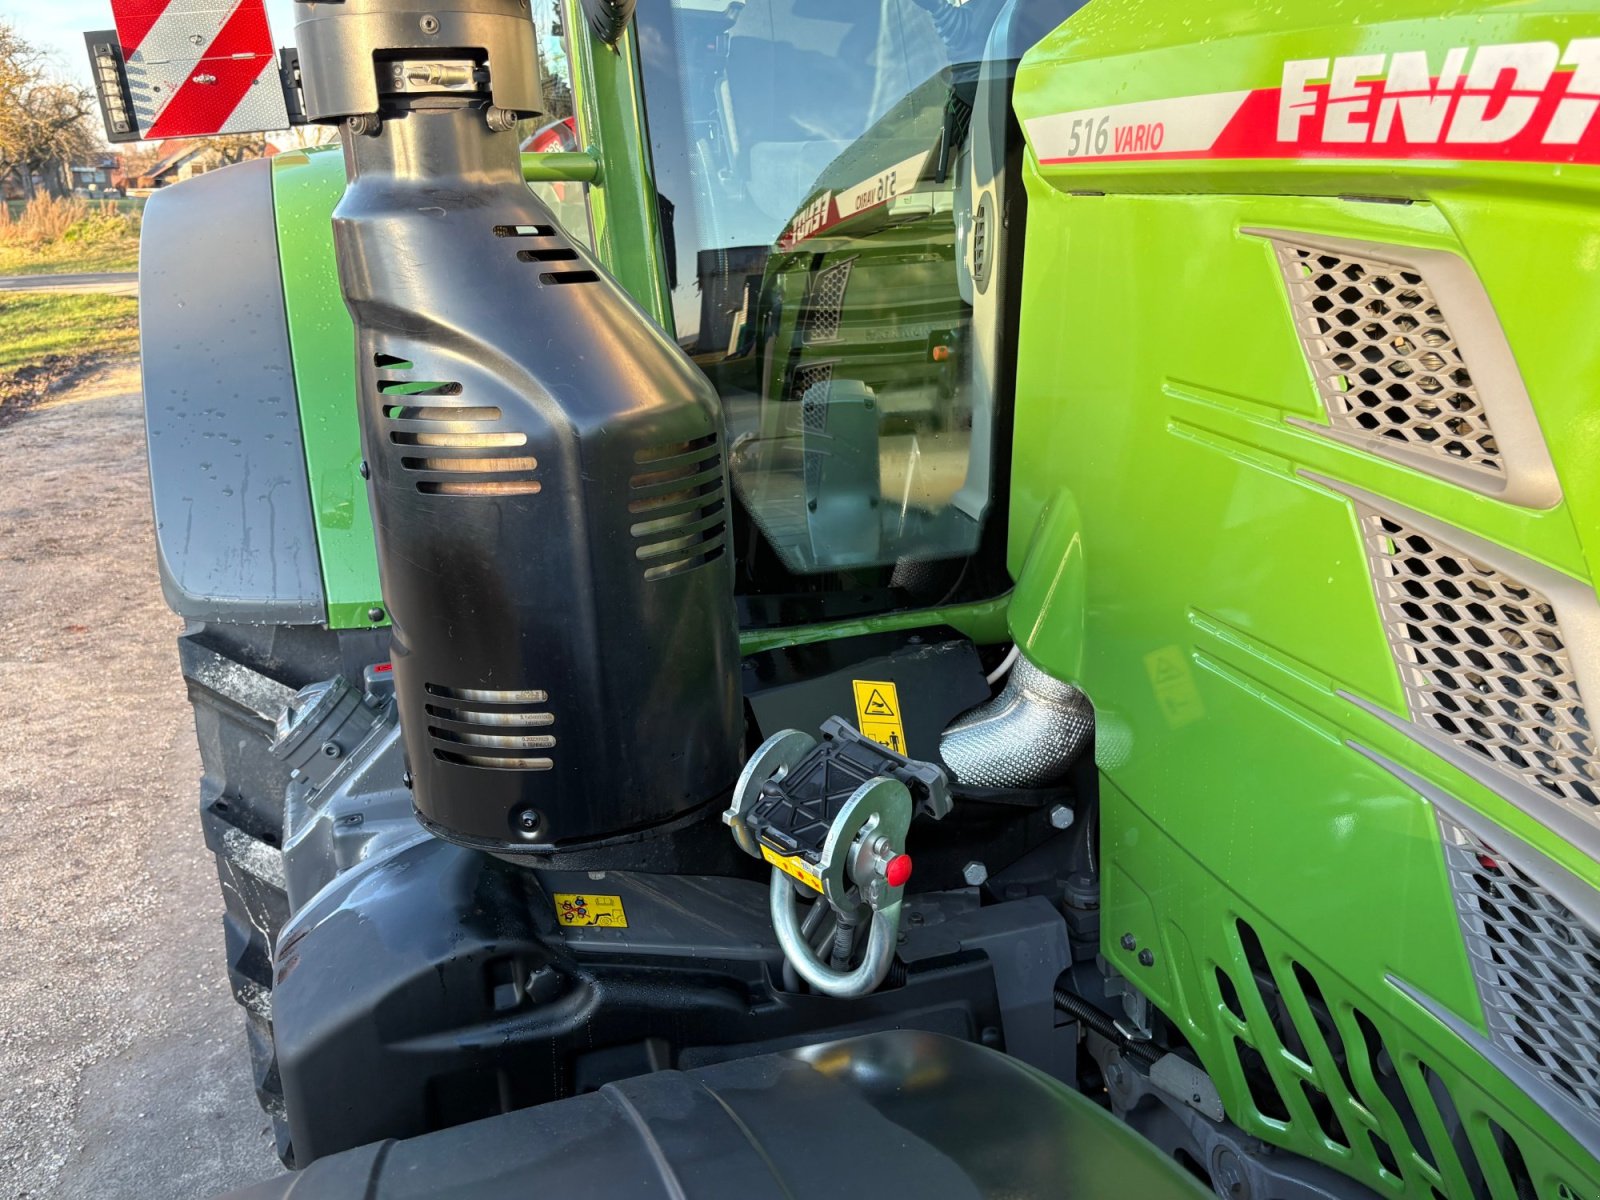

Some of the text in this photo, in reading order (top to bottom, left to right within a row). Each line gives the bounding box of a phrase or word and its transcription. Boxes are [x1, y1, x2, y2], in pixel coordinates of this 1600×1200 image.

[1276, 36, 1600, 144] FENDT
[1067, 115, 1165, 157] 516 VARIO
